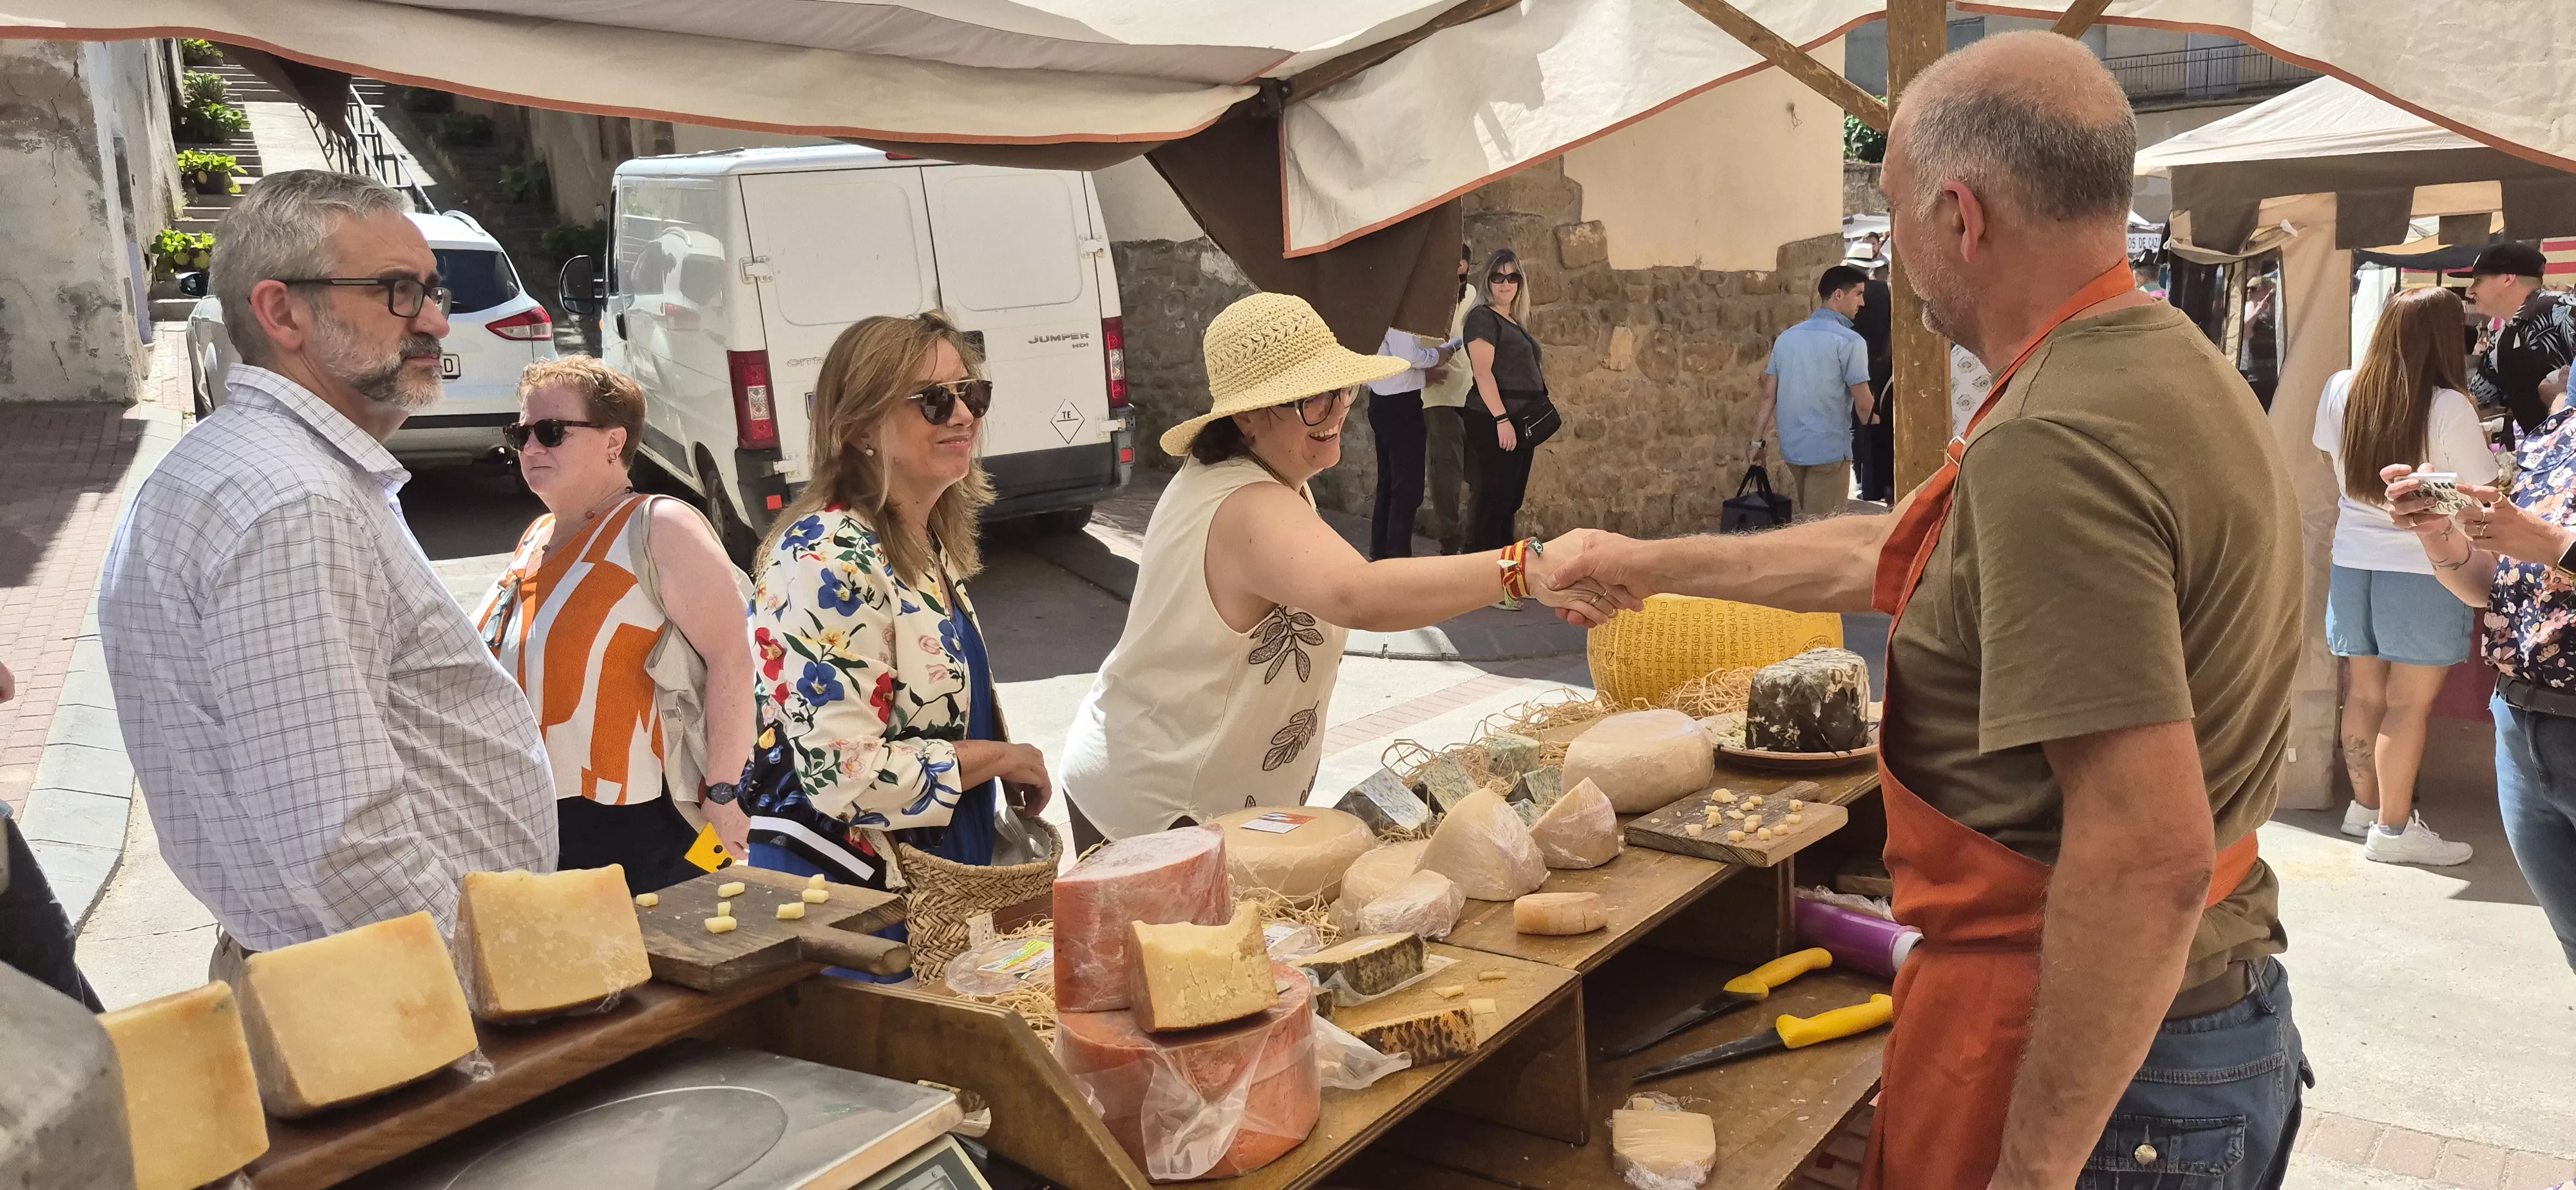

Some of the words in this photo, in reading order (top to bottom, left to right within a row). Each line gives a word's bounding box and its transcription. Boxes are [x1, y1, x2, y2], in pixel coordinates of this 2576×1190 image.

[2138, 237, 2146, 249] DE
[1027, 332, 1090, 345] JUMPER
[1062, 411, 1072, 419] TE
